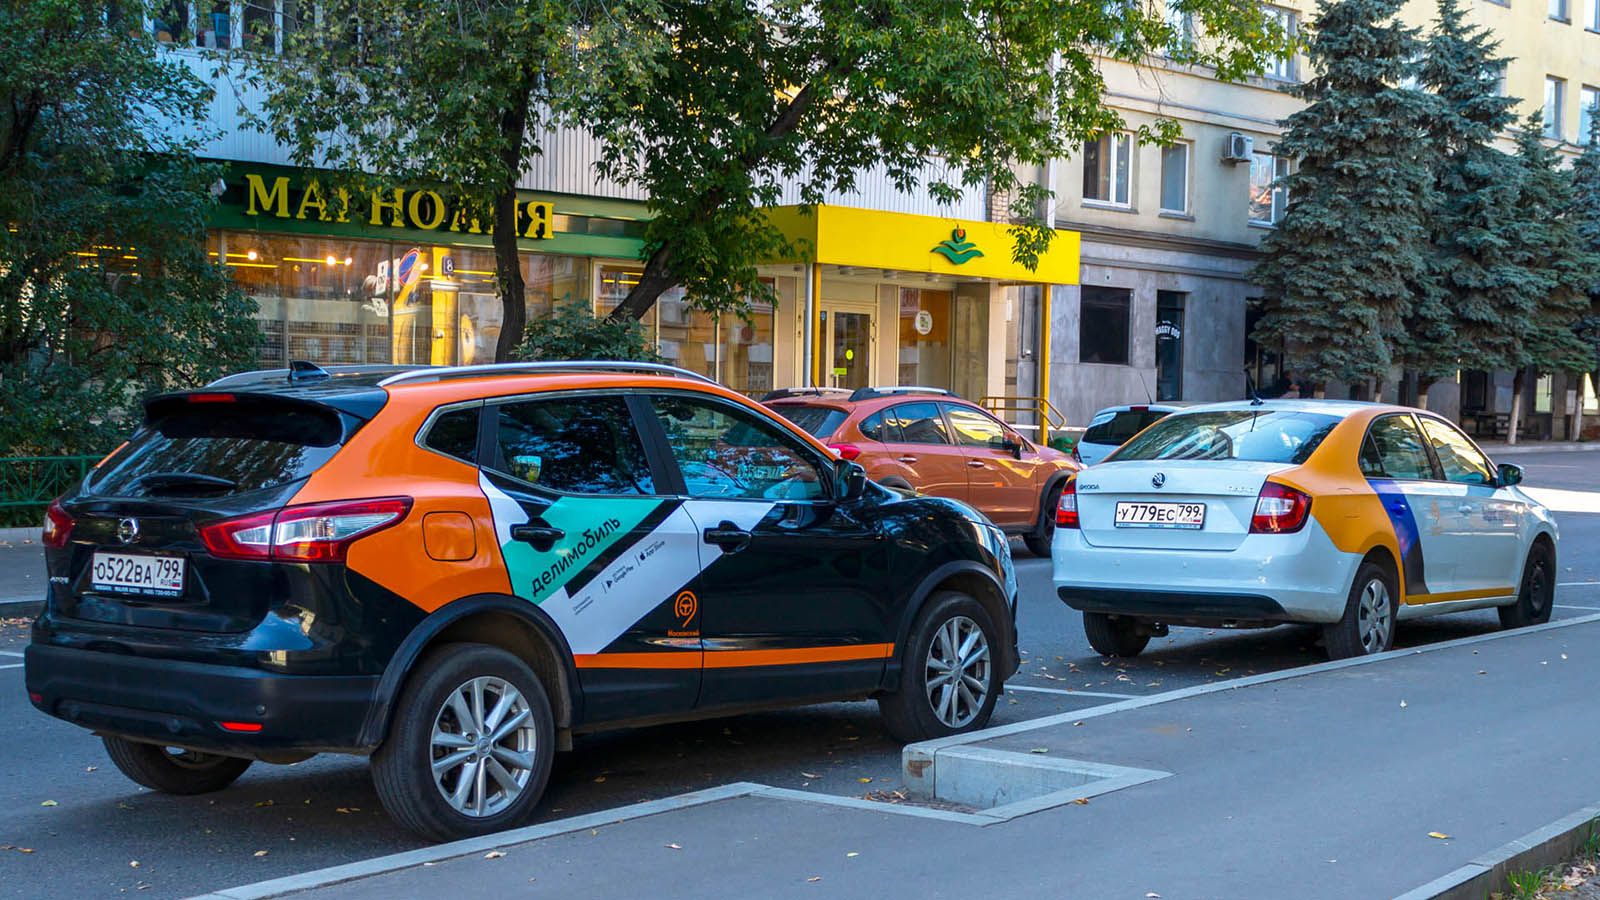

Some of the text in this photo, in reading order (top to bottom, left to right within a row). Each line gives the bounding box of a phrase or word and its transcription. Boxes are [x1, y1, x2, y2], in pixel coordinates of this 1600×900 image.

[245, 174, 554, 240] МАГНОЛЯ
[1178, 505, 1200, 517] 799
[156, 559, 180, 579] 799
[531, 518, 621, 598] делимобиль
